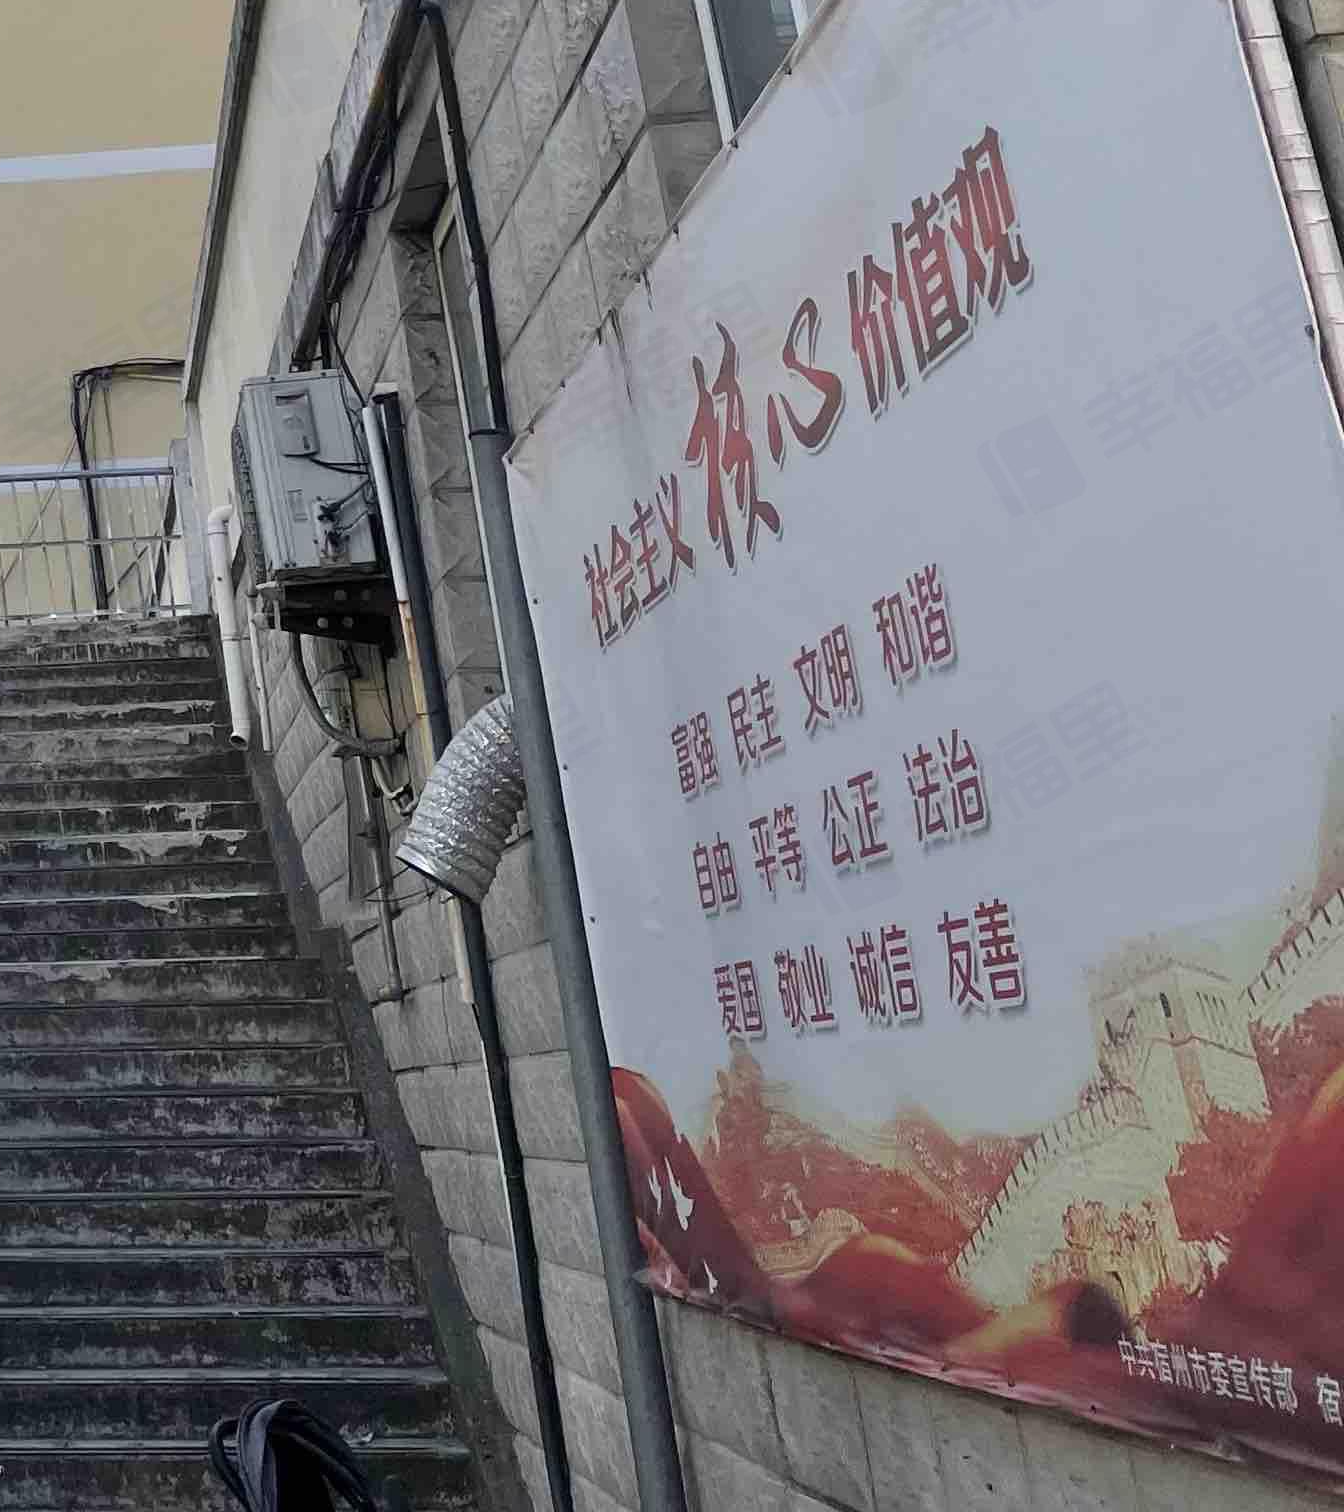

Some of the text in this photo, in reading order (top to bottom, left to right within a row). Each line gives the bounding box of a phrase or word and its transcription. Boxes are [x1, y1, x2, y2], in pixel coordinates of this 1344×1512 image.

[671, 563, 952, 795] 富强 民主 文明 和谐
[693, 729, 984, 910] 自由 平等 公正 法治
[714, 898, 1021, 1034] 爱国 敬业 诚信 友善
[1117, 1331, 1299, 1416] 中共宿州市委宣传部
